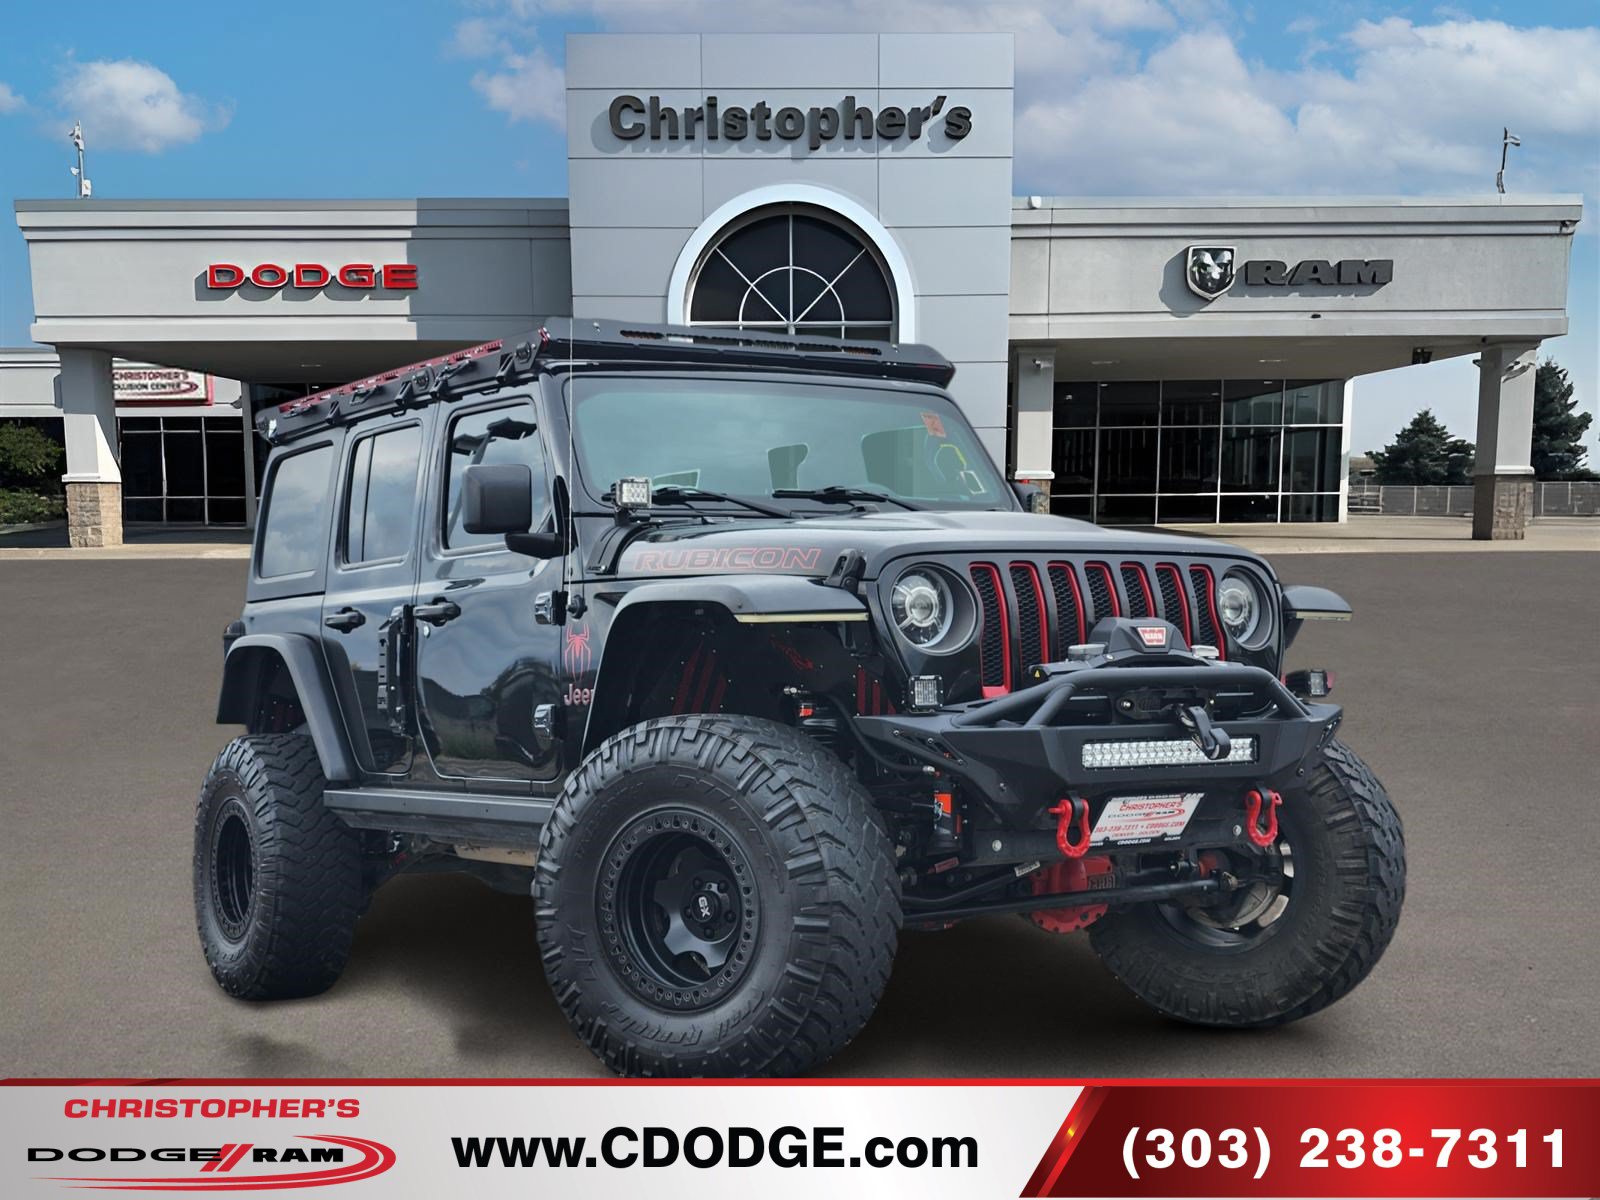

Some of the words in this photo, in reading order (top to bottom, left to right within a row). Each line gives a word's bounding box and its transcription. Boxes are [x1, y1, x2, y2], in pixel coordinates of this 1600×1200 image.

[608, 95, 972, 150] Christopher's
[207, 264, 417, 289] DODGE
[1245, 260, 1393, 285] RAM
[112, 382, 148, 391] OLLISION
[150, 382, 181, 391] CENTER
[633, 547, 821, 572] RUBICON
[563, 683, 594, 706] Jee
[1119, 800, 1184, 812] CHRISTOPHER'S
